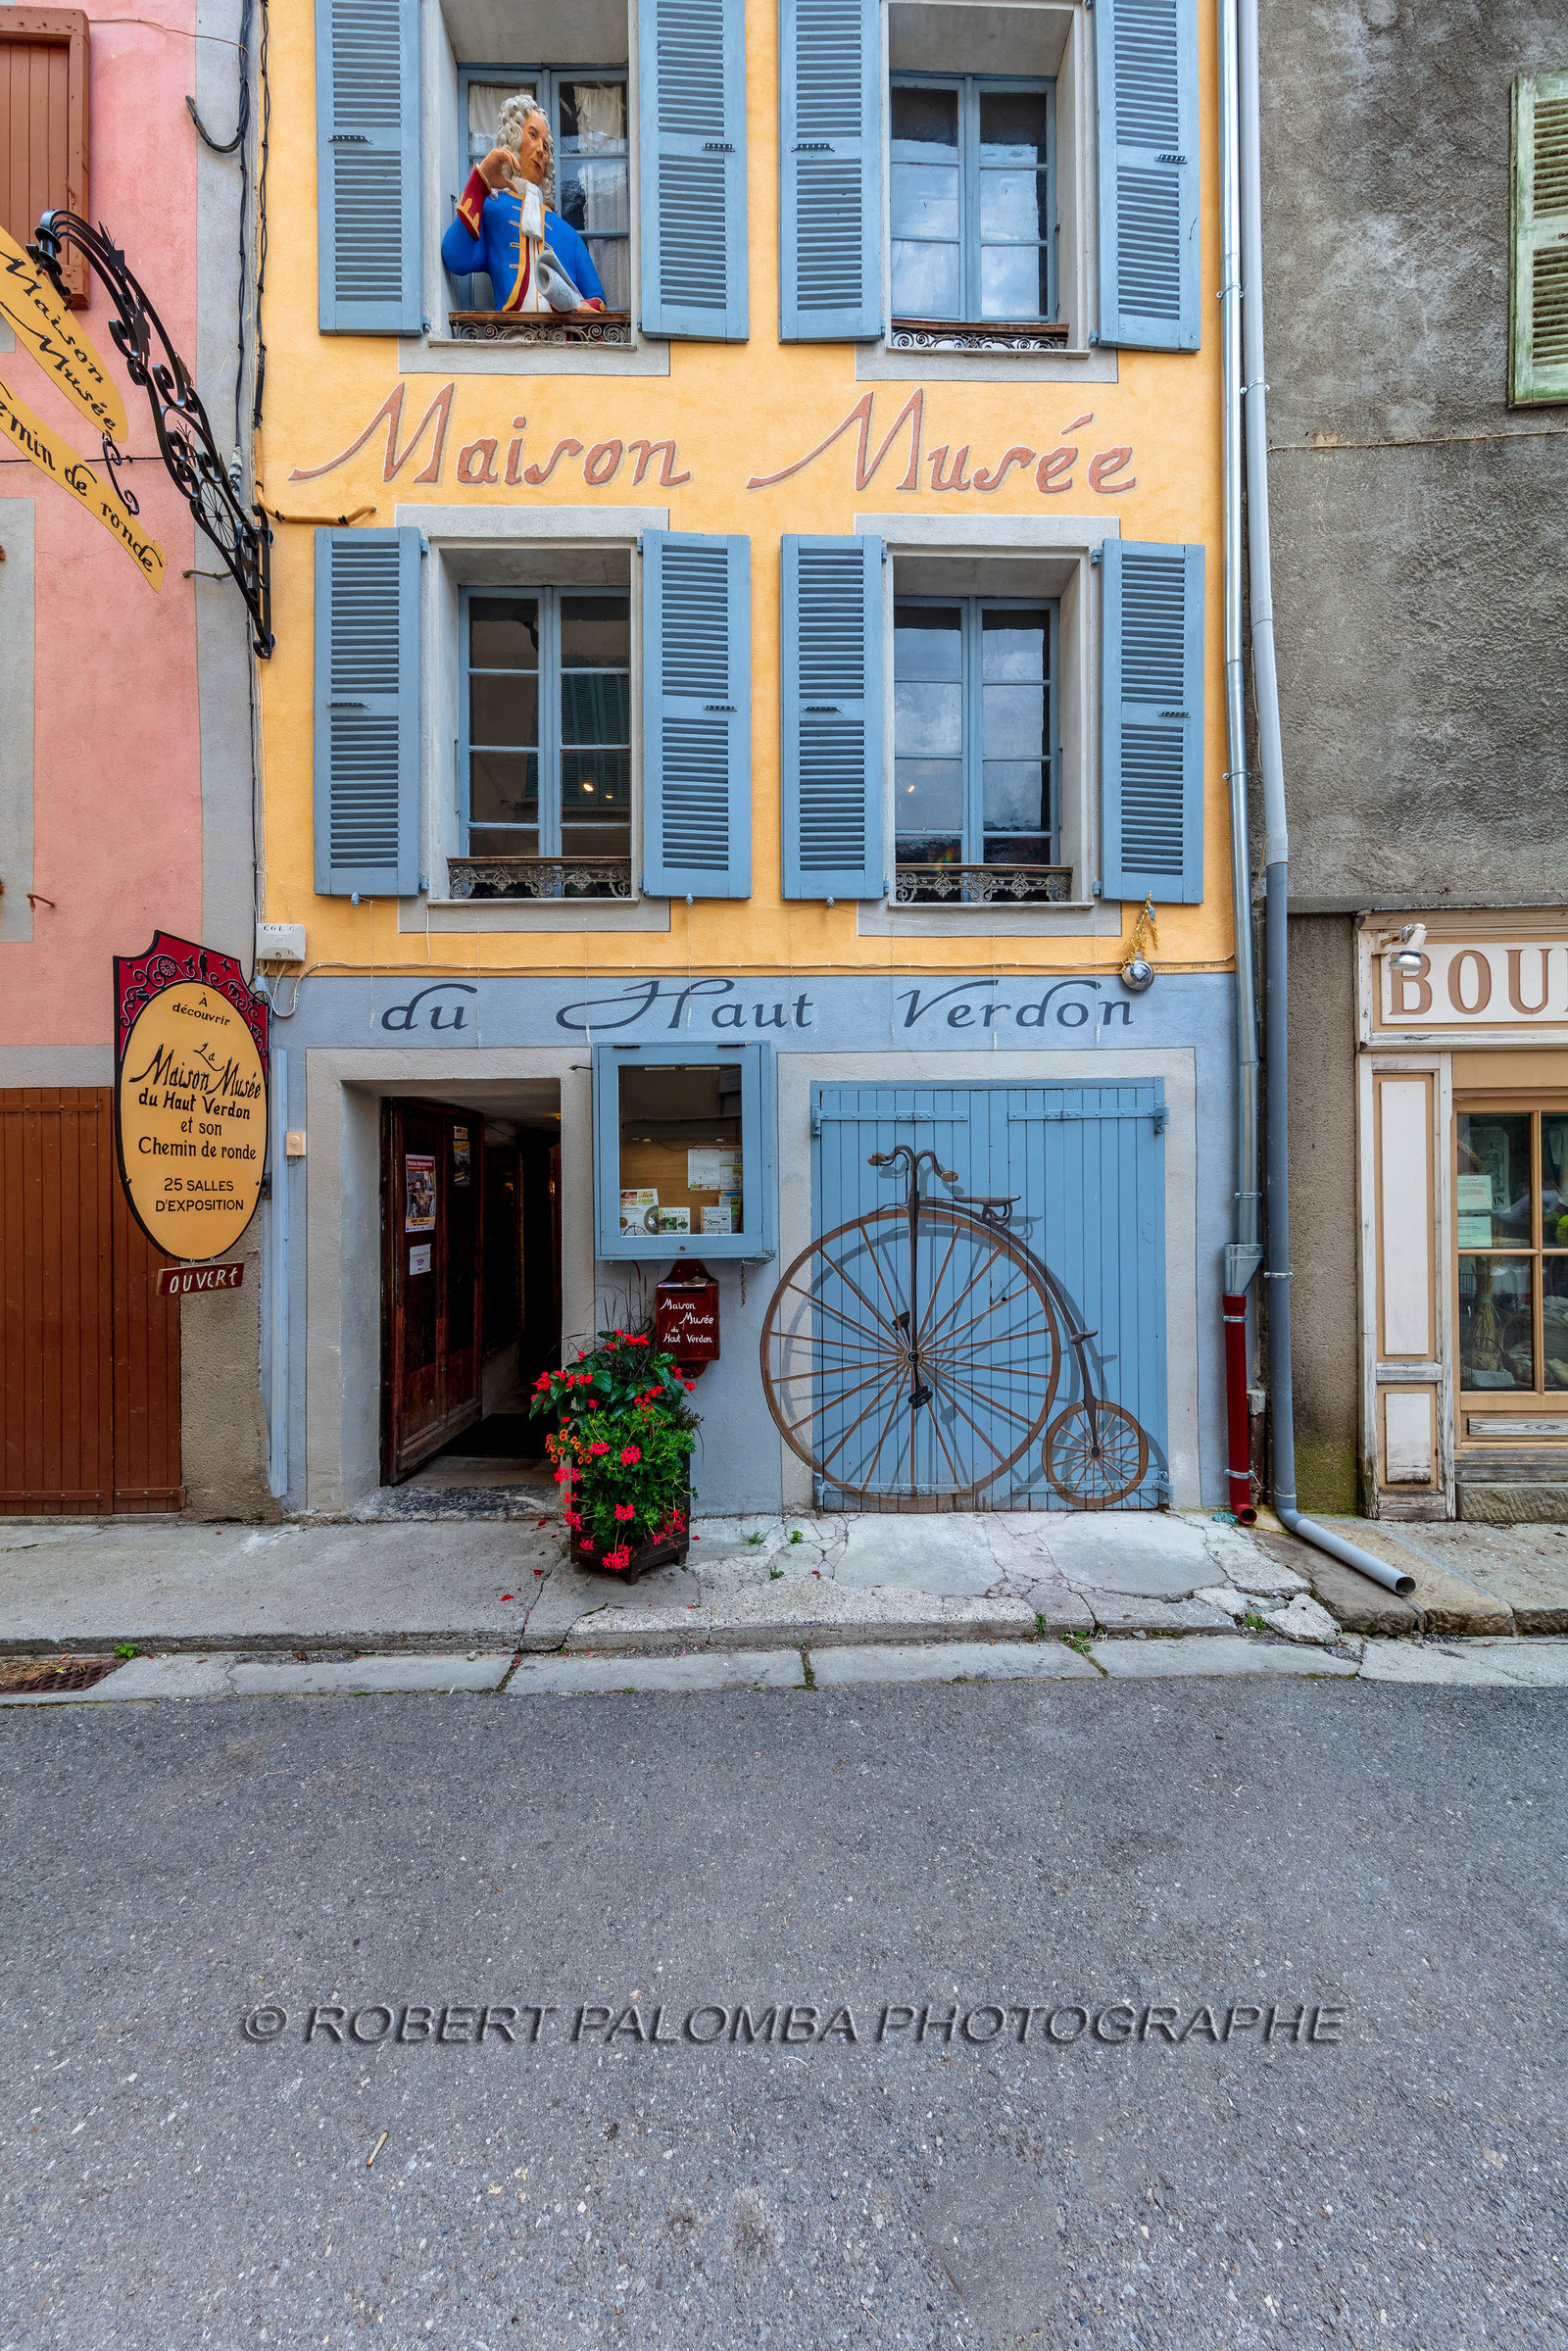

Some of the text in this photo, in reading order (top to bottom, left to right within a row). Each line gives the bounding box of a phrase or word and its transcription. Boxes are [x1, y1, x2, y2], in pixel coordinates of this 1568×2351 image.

[0, 250, 105, 383] Maison
[0, 301, 117, 430] Musée
[287, 380, 1138, 494] Maison Musée
[65, 464, 98, 496] de
[101, 502, 164, 572] ronde
[1388, 948, 1568, 1015] BOU
[198, 992, 209, 1008] À
[380, 978, 1135, 1032] du Haut Verdon
[172, 1003, 231, 1027] découvrir
[193, 1043, 224, 1071] La
[129, 1043, 262, 1100] Maison Musée
[138, 1088, 251, 1120] du Haut Verdon
[180, 1117, 222, 1136] et son
[138, 1136, 257, 1160] Chemin de ronde
[164, 1177, 234, 1193] 25 SALLES
[155, 1199, 244, 1213] D'EXPOSITION
[660, 1298, 697, 1310] Maison
[678, 1311, 714, 1325] Musée
[686, 1334, 713, 1343] Verdon
